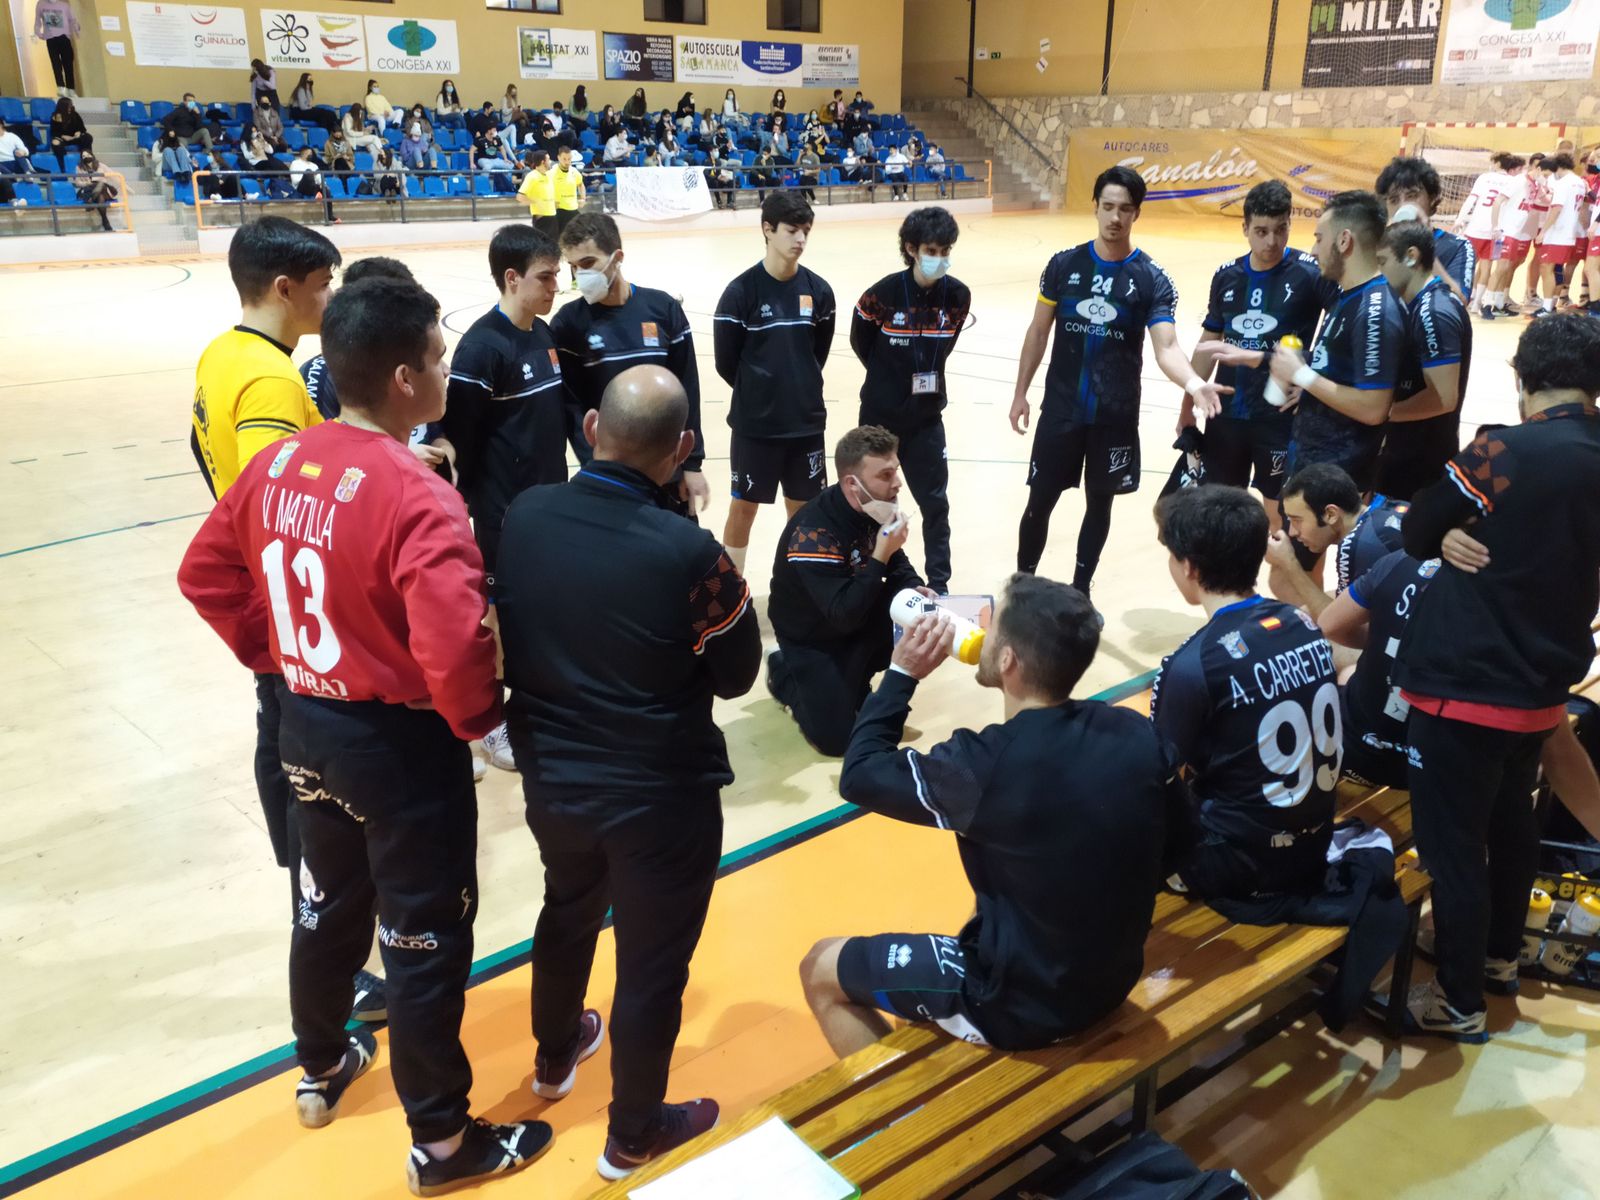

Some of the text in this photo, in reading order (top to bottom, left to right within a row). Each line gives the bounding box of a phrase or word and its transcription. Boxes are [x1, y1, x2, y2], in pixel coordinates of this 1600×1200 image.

[1340, 0, 1441, 32] MILAR
[194, 34, 246, 48] GUINALDO
[1478, 31, 1567, 46] CONGESA XXI
[532, 43, 589, 56] HABITAT XXI
[606, 50, 642, 64] SPAZIO
[683, 42, 740, 57] AUTOESCUELA
[271, 54, 311, 64] vitaterra
[377, 58, 452, 71] CONGESA XXI
[680, 57, 739, 72] SALAMANCA
[620, 64, 641, 72] TERMAS
[1103, 142, 1169, 152] AUTOCARES
[1481, 189, 1499, 207] 3
[1091, 274, 1114, 295] 24
[1250, 288, 1262, 307] 8
[1088, 303, 1107, 317] CG
[1064, 321, 1112, 337] CONGESA
[1242, 319, 1264, 330] CG
[307, 356, 326, 405] SALAM
[263, 484, 336, 551] V. MATILLA
[261, 538, 342, 674] 13
[1396, 583, 1417, 619] S.
[1230, 638, 1336, 708] A. CARRETER
[1258, 682, 1344, 808] 99
